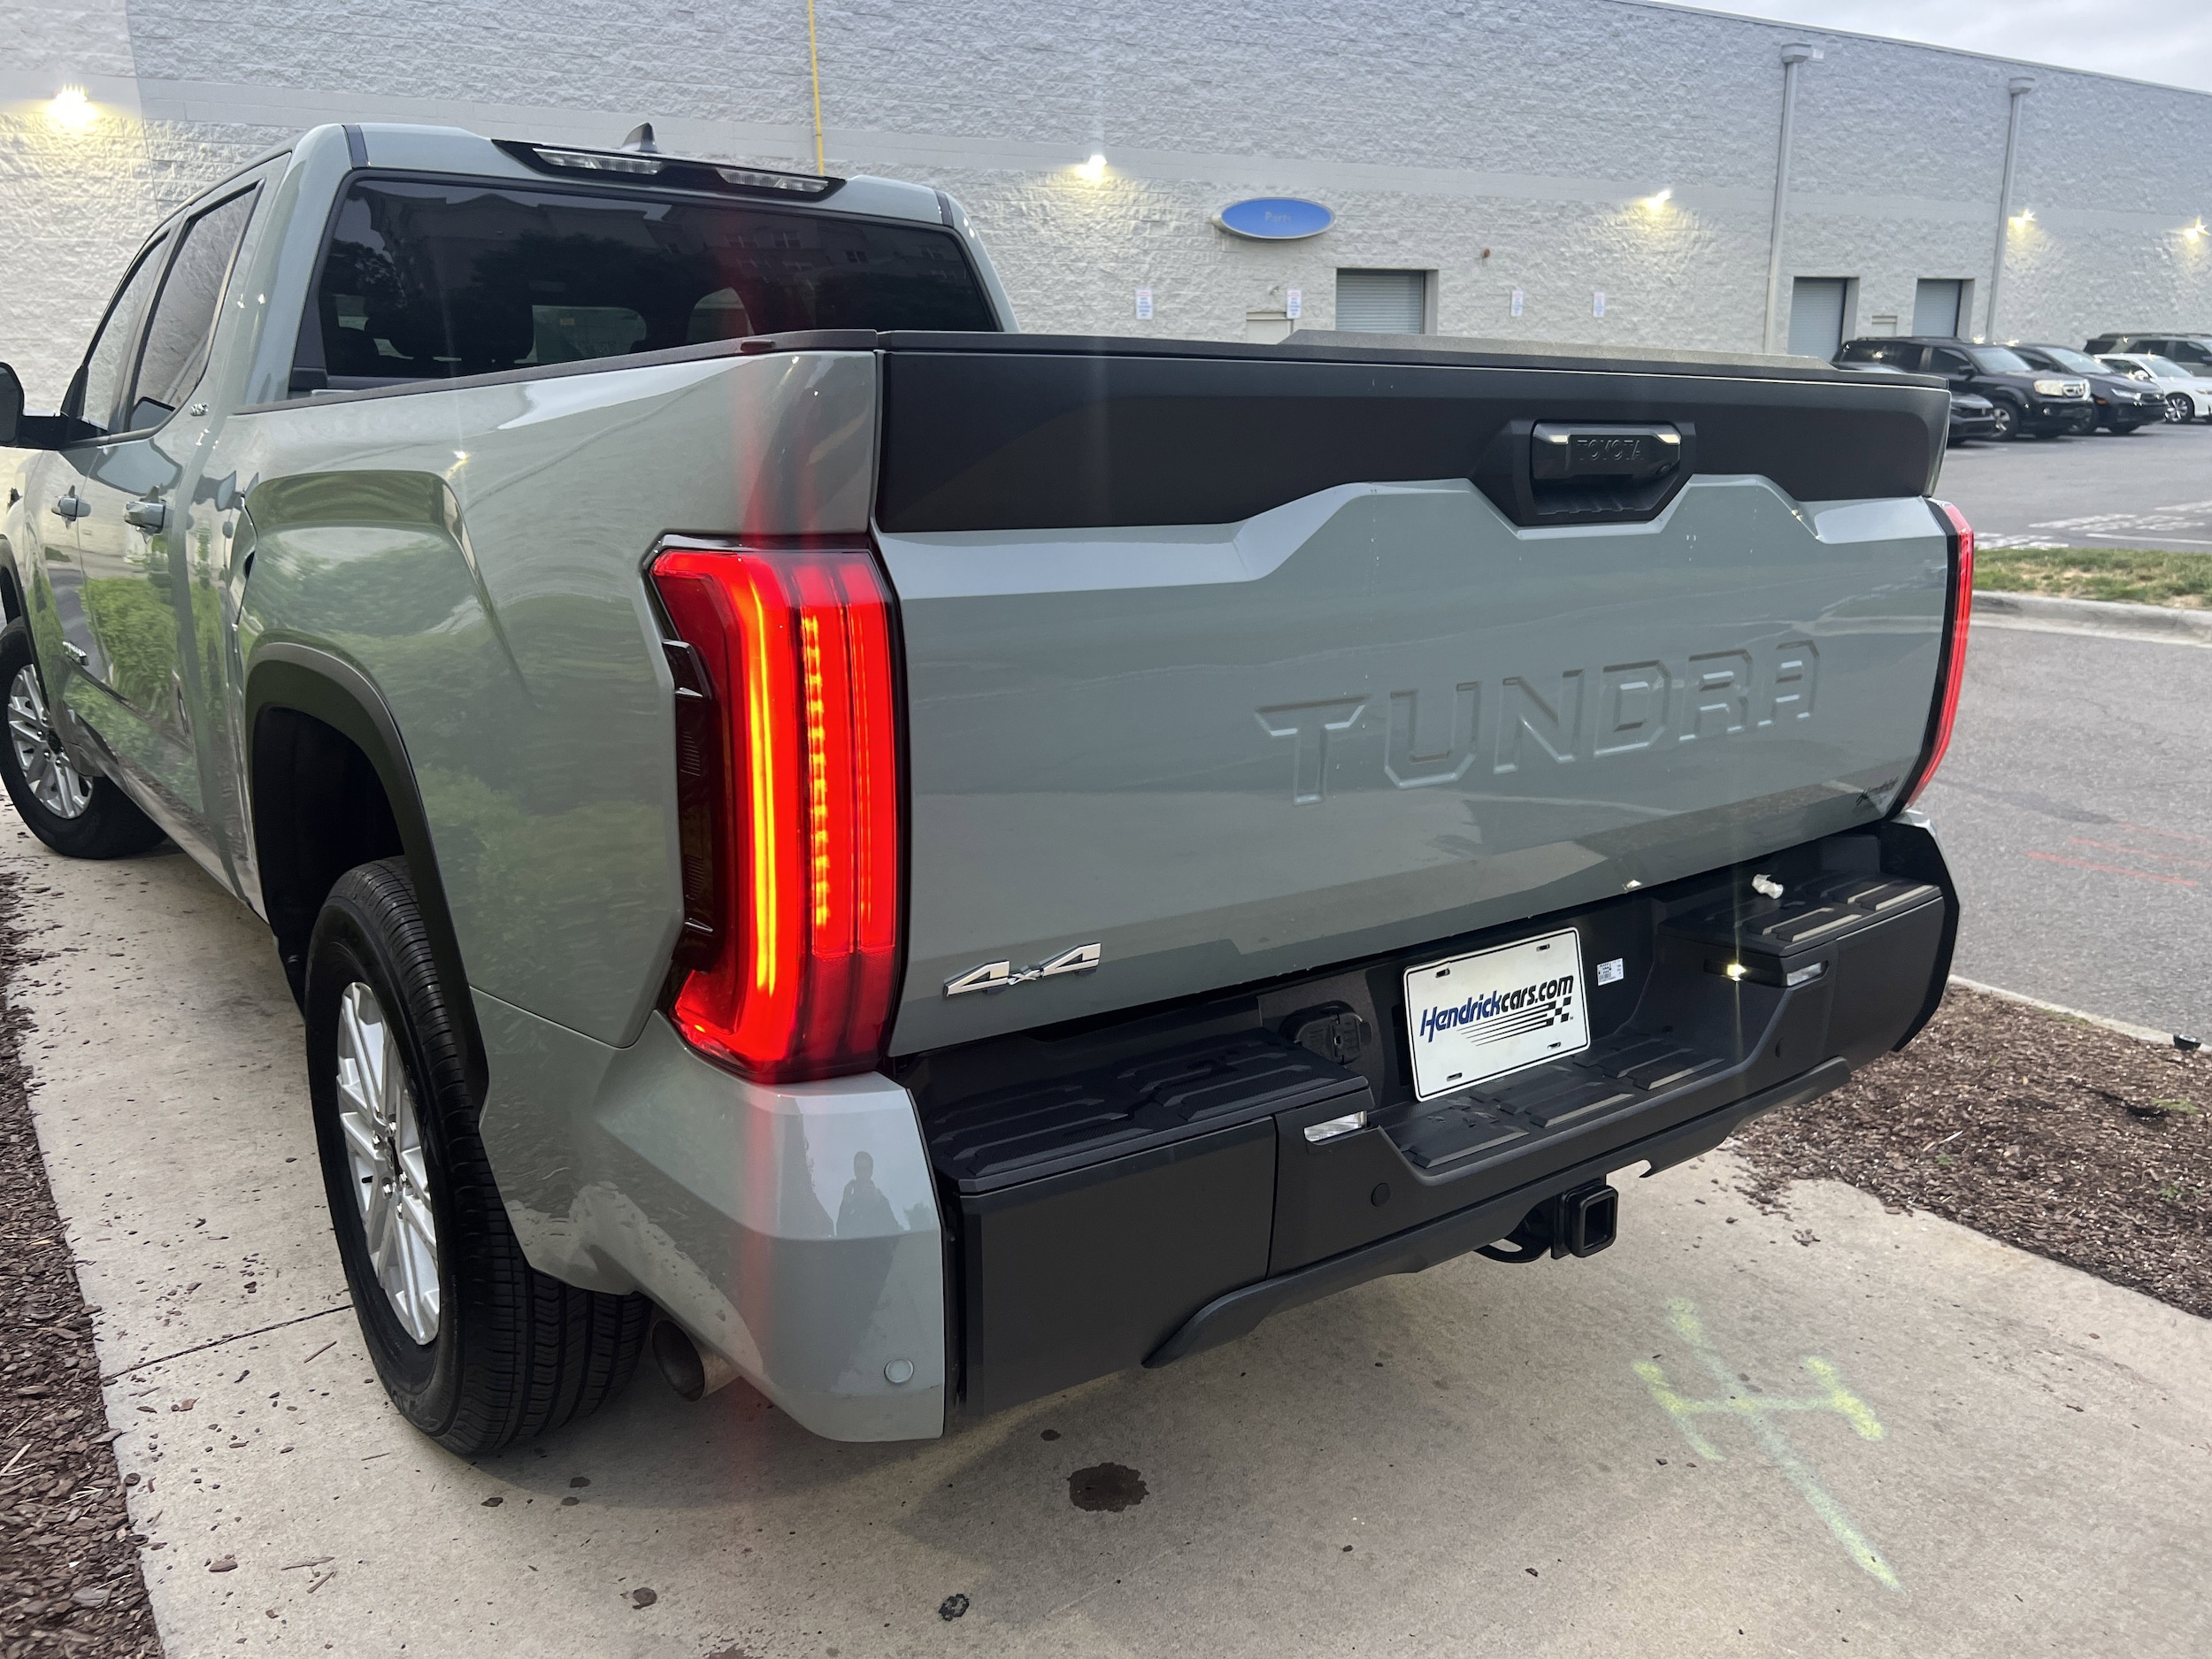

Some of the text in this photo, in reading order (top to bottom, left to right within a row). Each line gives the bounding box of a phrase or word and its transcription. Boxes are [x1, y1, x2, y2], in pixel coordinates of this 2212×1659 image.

[1577, 439, 1645, 461] TOYOTA
[1255, 640, 1821, 806] TUNDRA
[1419, 975, 1574, 1043] Hendrickcars.com
